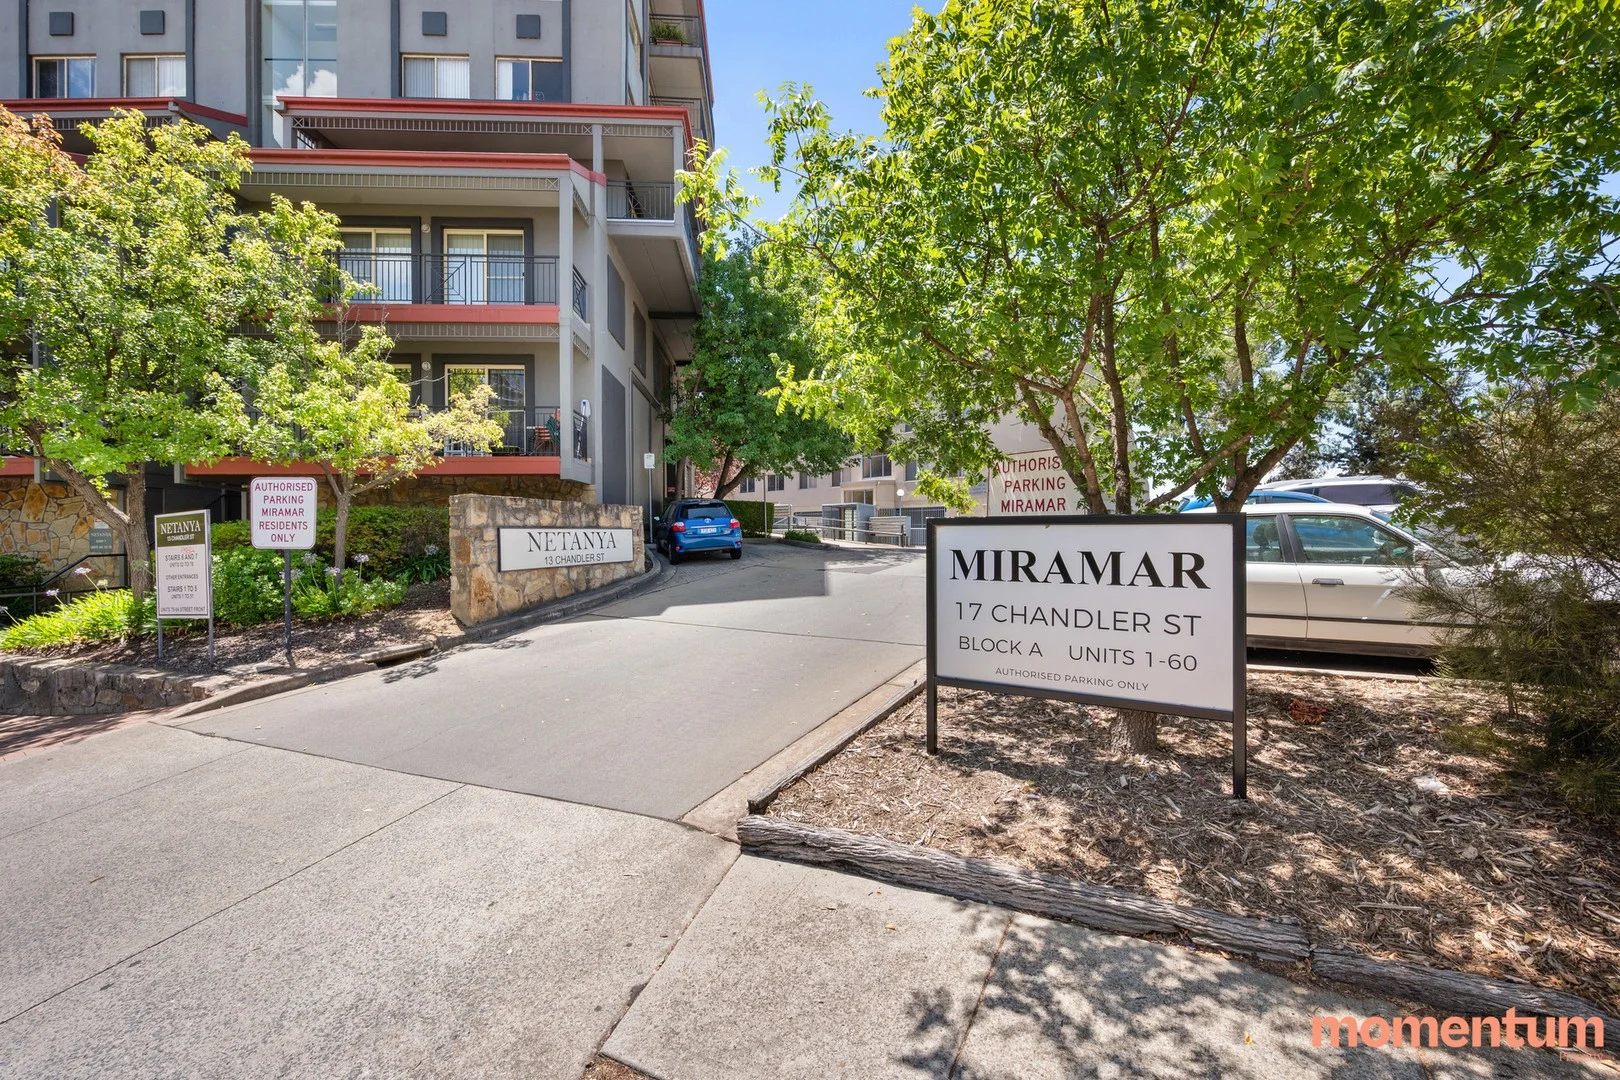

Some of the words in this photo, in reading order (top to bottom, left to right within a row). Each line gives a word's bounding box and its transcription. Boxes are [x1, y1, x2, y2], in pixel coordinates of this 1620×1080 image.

[995, 456, 1061, 474] AUTHORIS
[255, 482, 313, 492] AUTHORISED
[1005, 477, 1065, 493] PARKING
[264, 496, 304, 504] PARKING
[1002, 498, 1066, 512] MIRAMAR
[261, 508, 304, 517] MIRAMAR
[160, 520, 201, 534] NETANYA
[259, 521, 308, 530] RESIDENTS
[271, 534, 295, 543] ONLY
[528, 531, 616, 552] NETANYA
[544, 556, 553, 565] 13
[555, 554, 595, 565] CHANDLER
[595, 553, 605, 562] ST
[949, 549, 1211, 590] MIRAMAR
[956, 602, 982, 621] 17
[991, 604, 1151, 633] CHANDLER
[1164, 614, 1202, 636] ST
[960, 636, 1021, 655] BLOCK
[1029, 642, 1042, 657] A
[1069, 646, 1135, 666] UNITS
[1146, 652, 1198, 671] 1-60
[995, 667, 1061, 682] AUTHORISED
[1065, 674, 1114, 688] PARKING
[1118, 681, 1149, 692] ONLY
